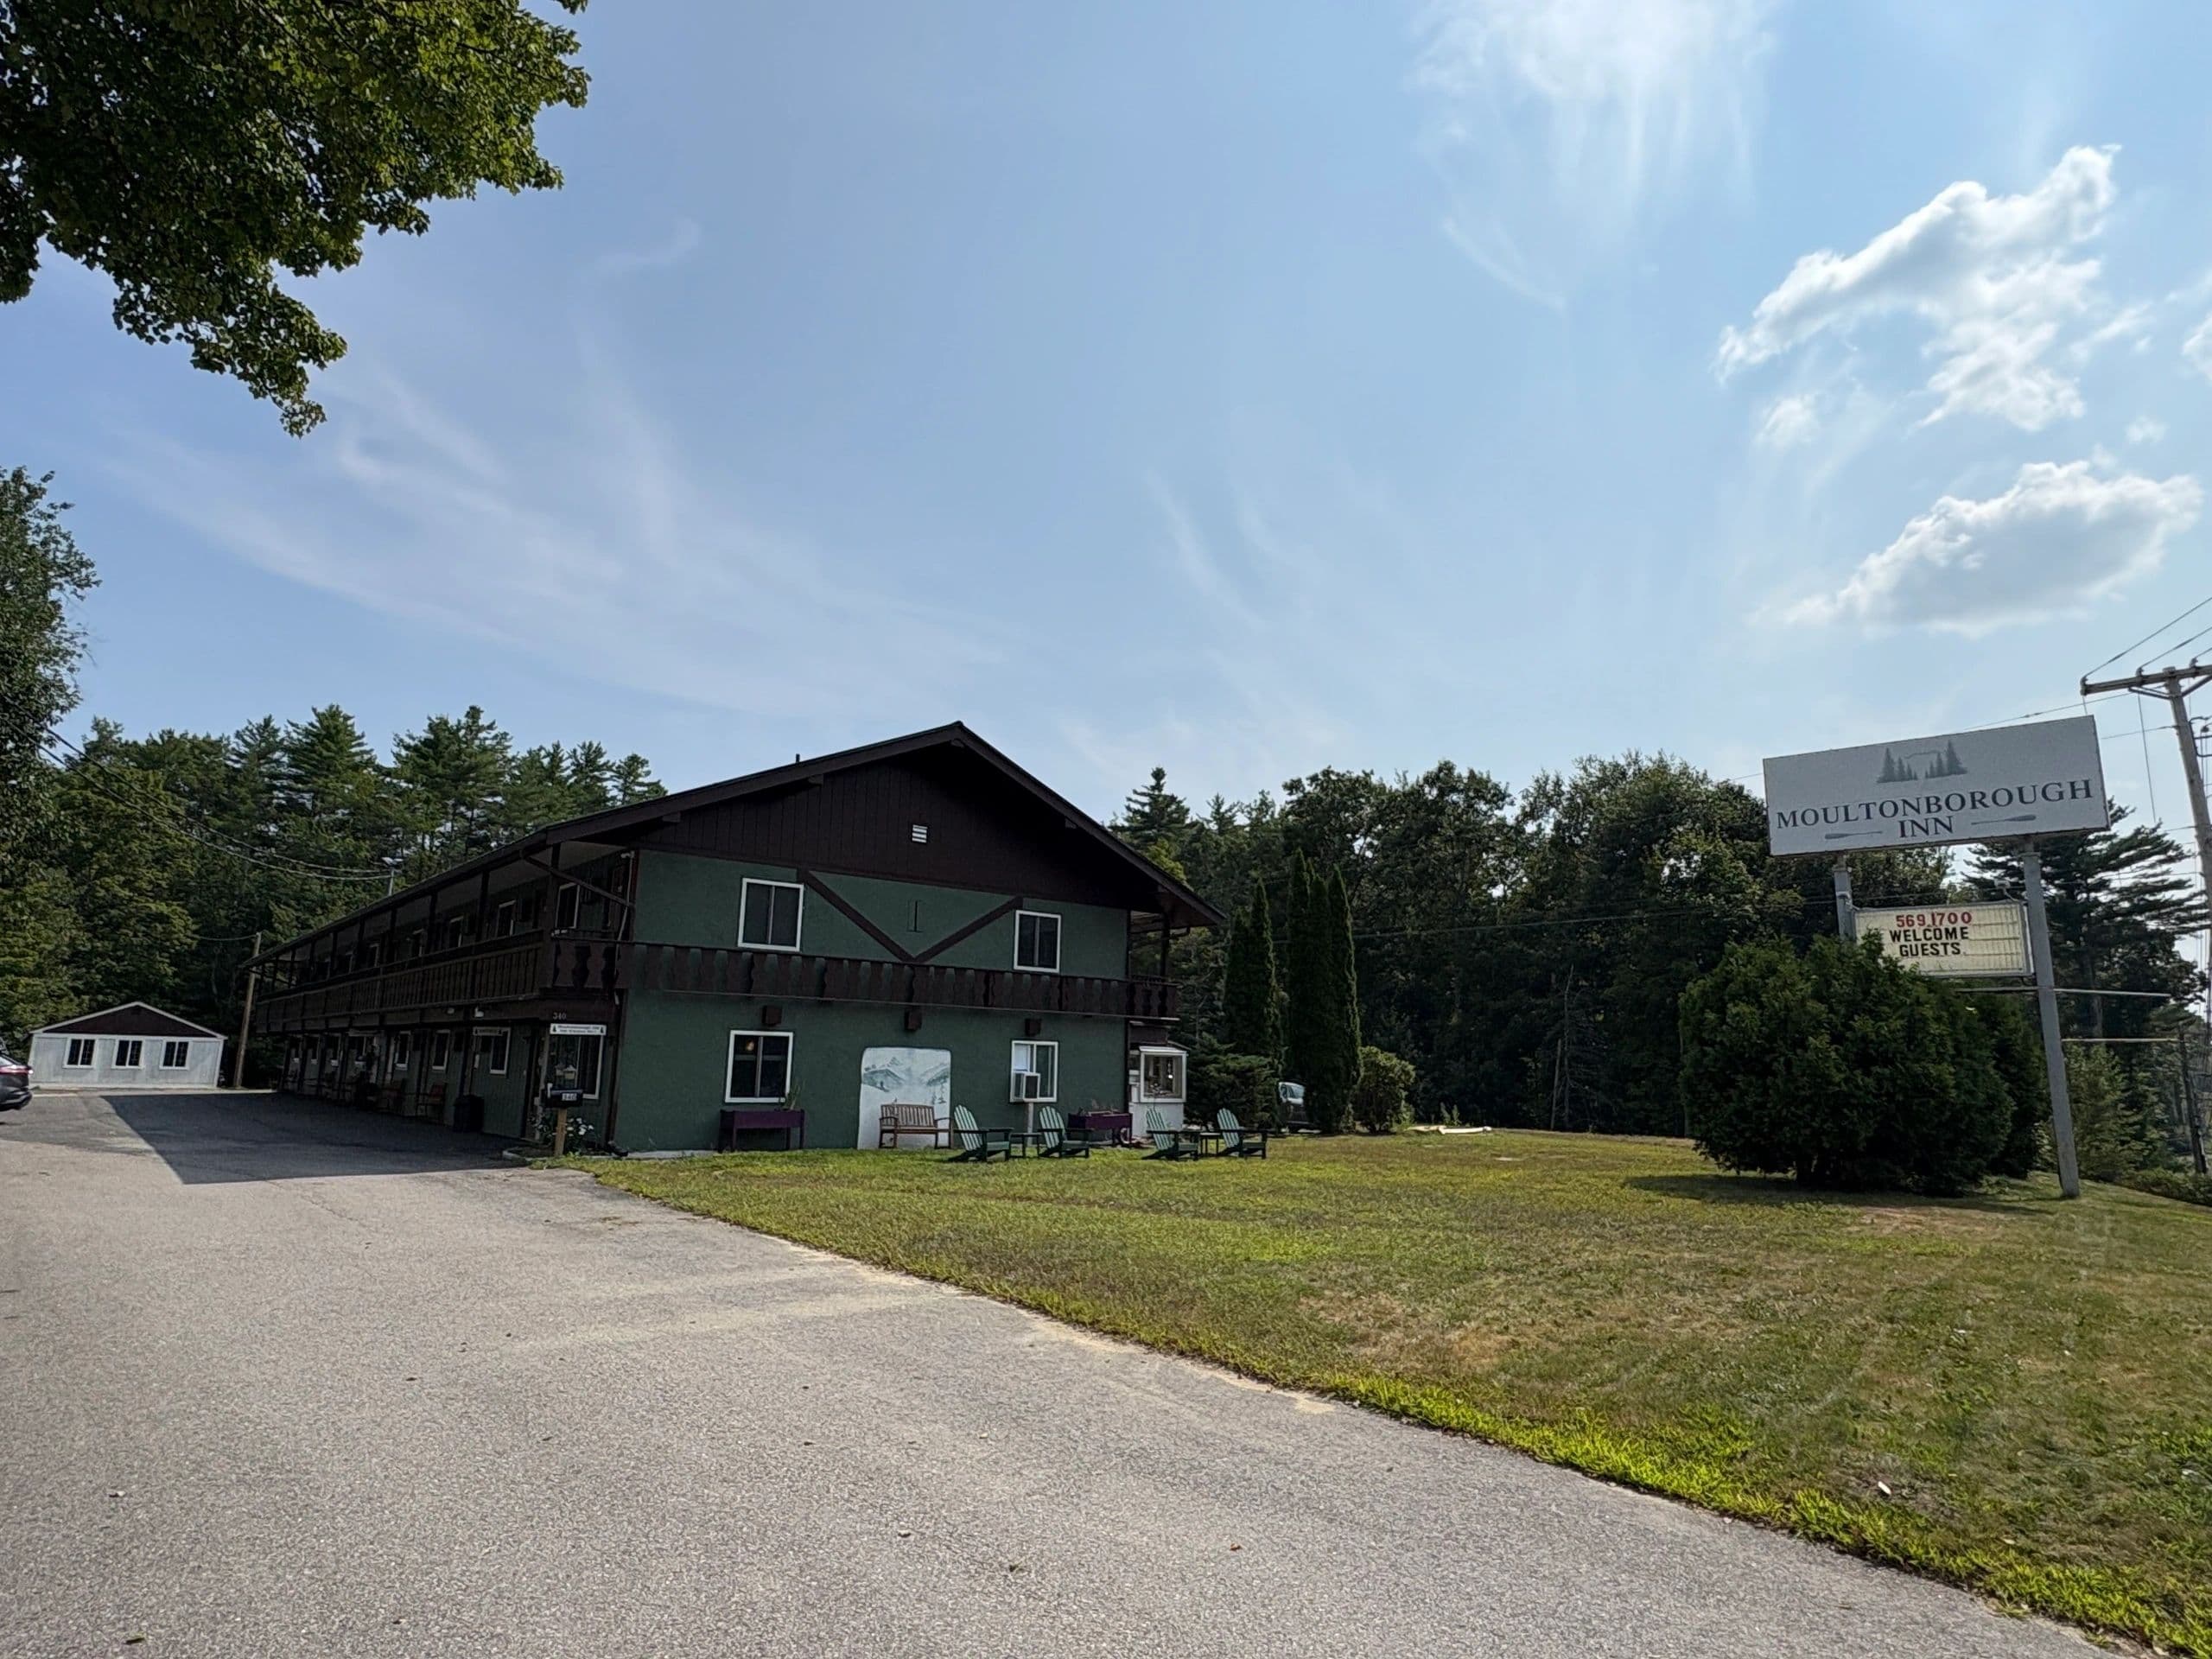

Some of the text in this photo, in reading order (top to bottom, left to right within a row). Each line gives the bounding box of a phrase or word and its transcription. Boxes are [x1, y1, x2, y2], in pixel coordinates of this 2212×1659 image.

[1777, 779, 2092, 829] MOULTONBOROUGH
[1900, 816, 1954, 838] INN
[1890, 926, 1968, 943] WELCOME
[1899, 942, 1961, 957] GUESTS
